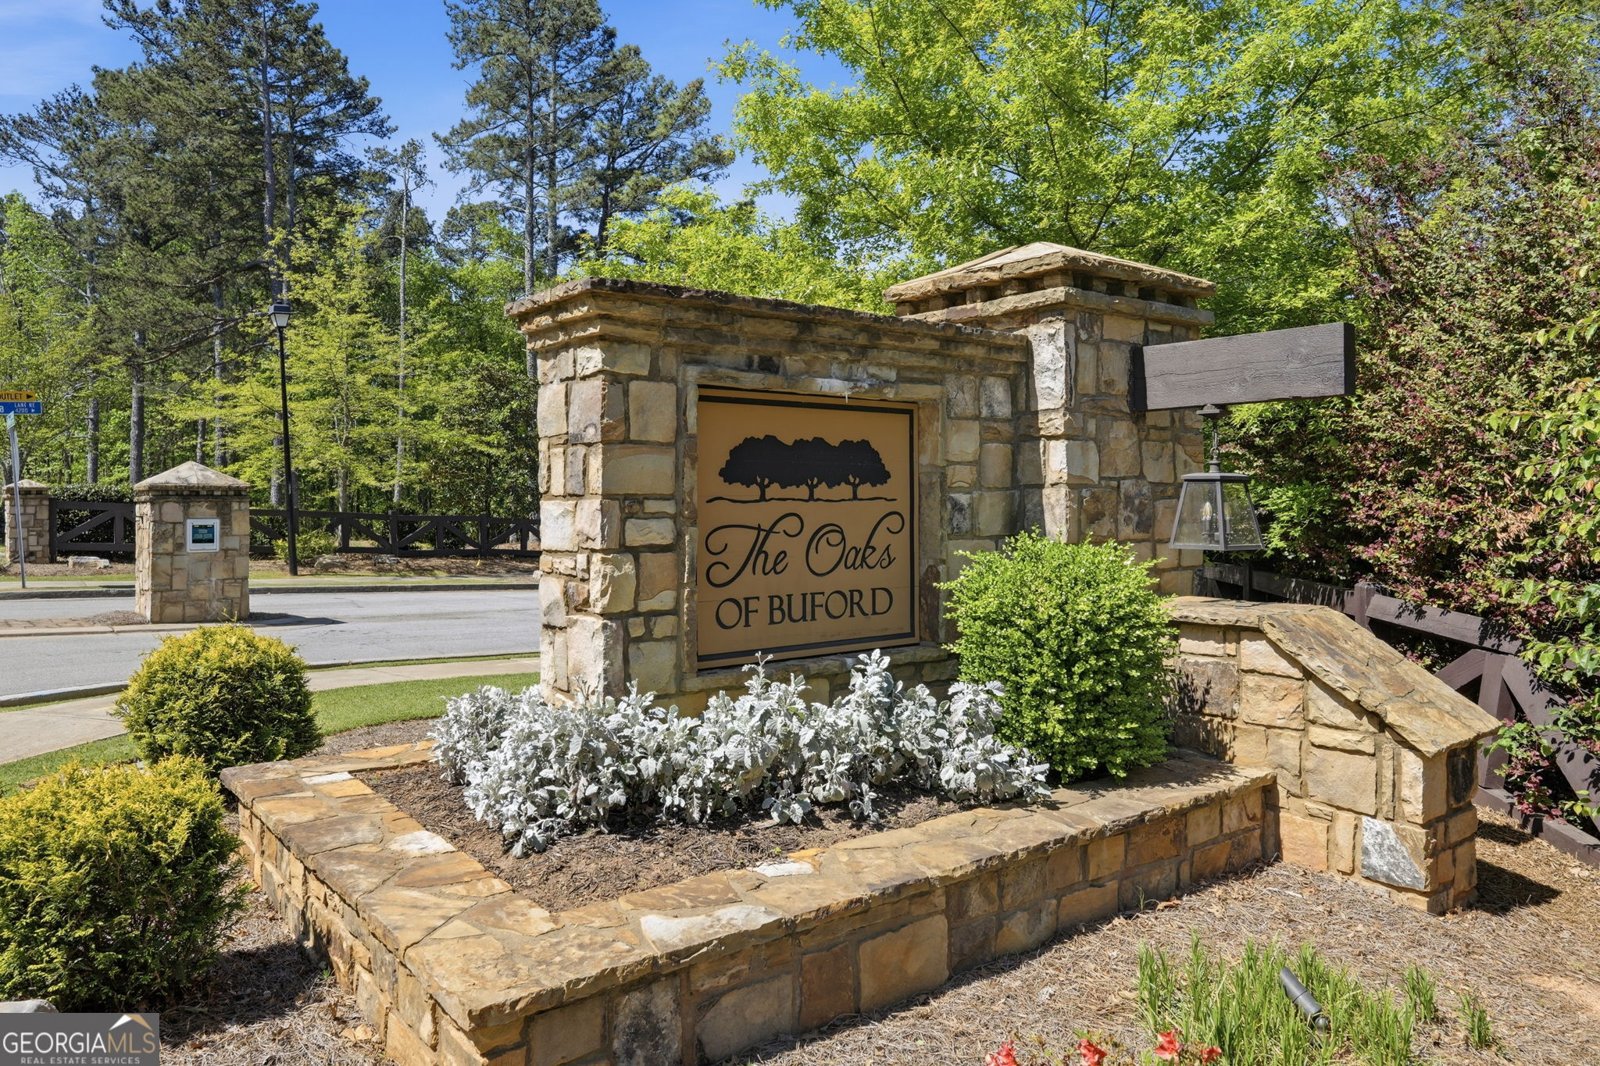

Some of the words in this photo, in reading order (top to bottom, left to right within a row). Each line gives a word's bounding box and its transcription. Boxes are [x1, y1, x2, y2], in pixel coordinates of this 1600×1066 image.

[705, 512, 804, 588] The
[805, 511, 905, 577] Oaks
[715, 596, 760, 629] OF
[768, 587, 893, 625] BUFORD
